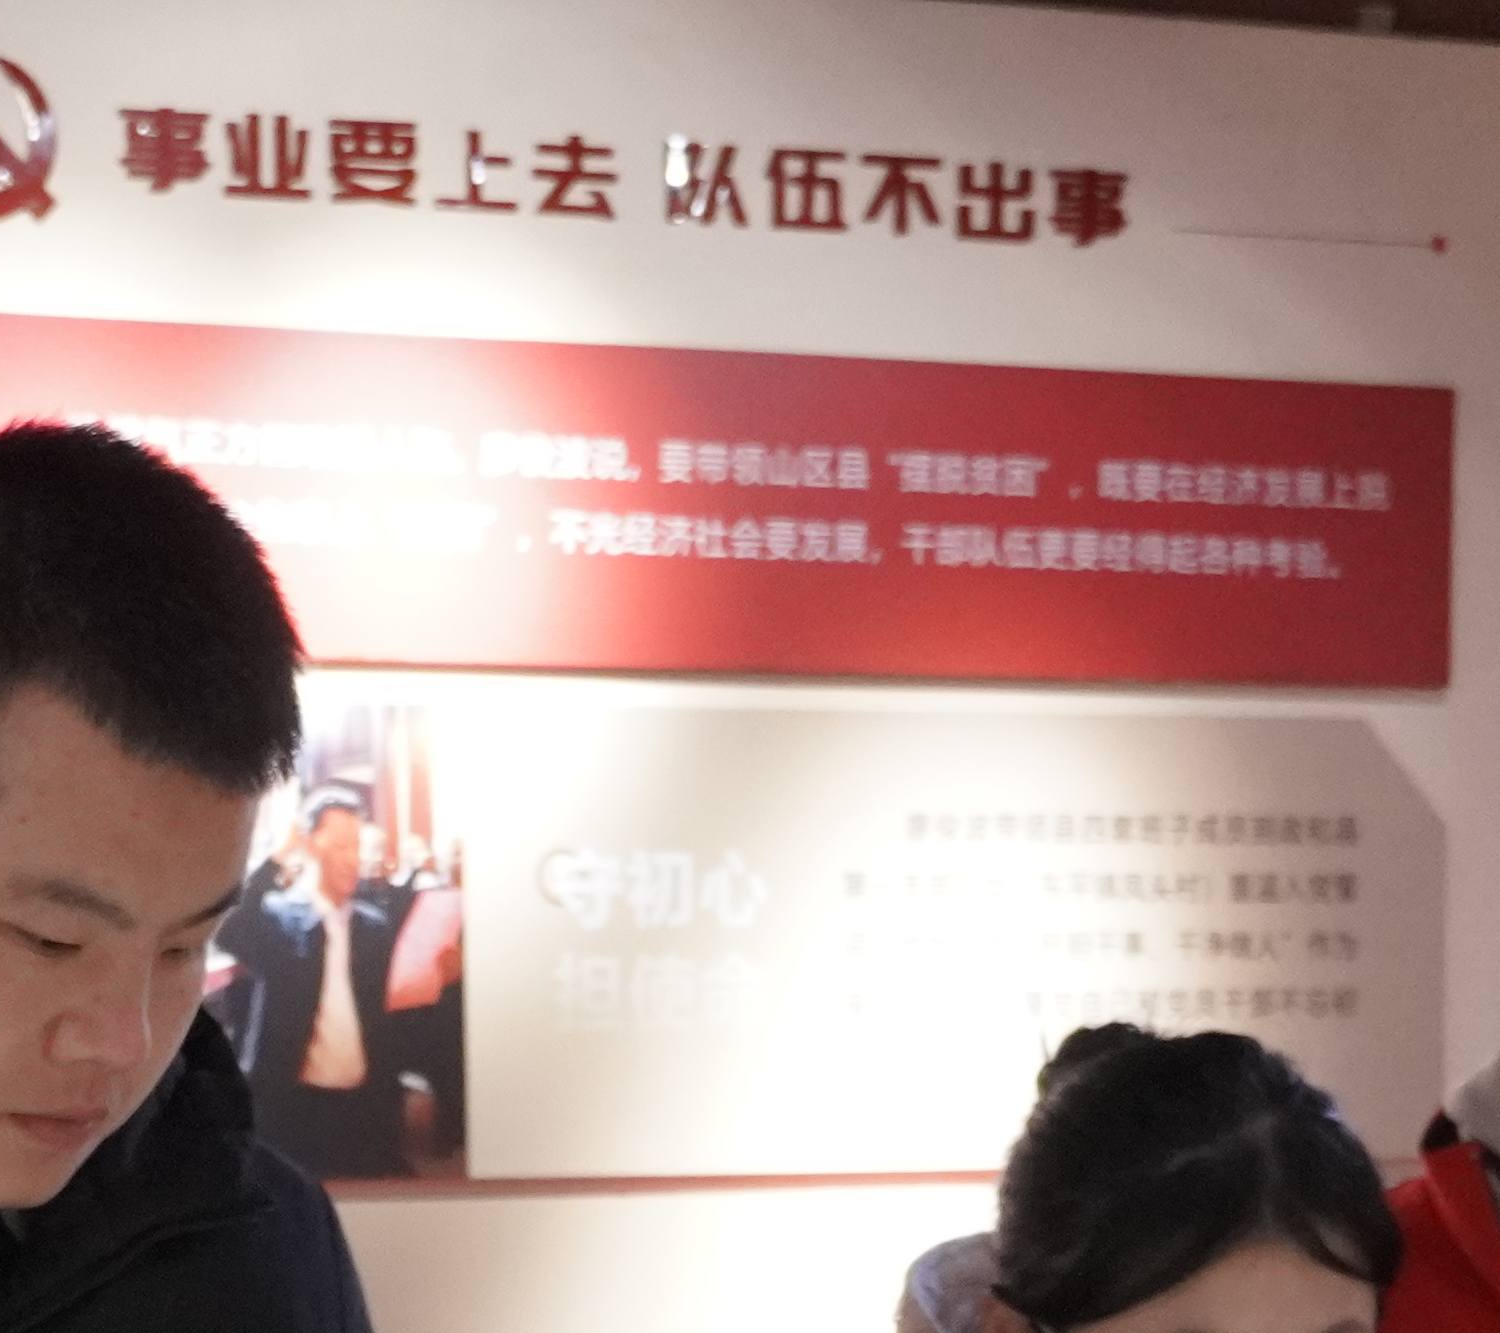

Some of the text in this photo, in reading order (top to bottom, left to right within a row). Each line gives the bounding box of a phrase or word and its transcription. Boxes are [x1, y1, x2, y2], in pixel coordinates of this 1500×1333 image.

[118, 108, 1128, 247] 事业要上去 队伍不出事
[553, 847, 768, 931] 守初心
